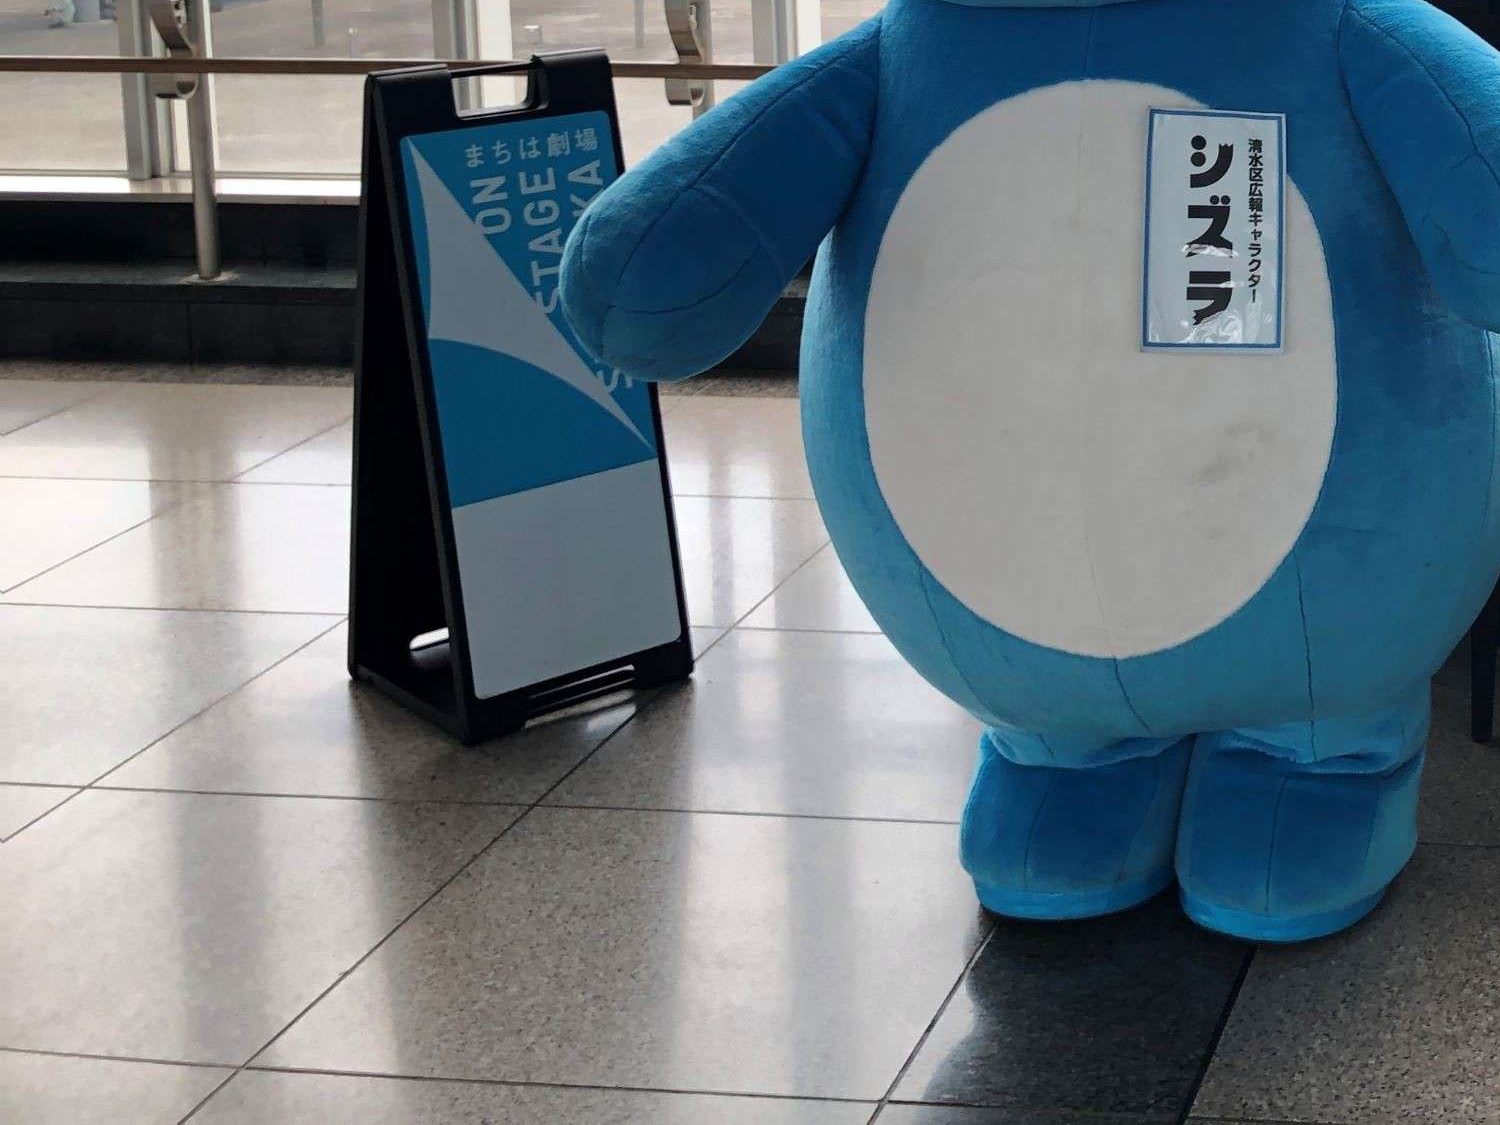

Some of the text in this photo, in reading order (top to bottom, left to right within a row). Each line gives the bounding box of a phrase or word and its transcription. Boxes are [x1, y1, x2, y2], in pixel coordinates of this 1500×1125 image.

[465, 128, 599, 168] まちは劇場
[470, 175, 513, 235] ON
[518, 167, 566, 314] STAGE
[1248, 138, 1263, 304] 清水区広報キャラクター
